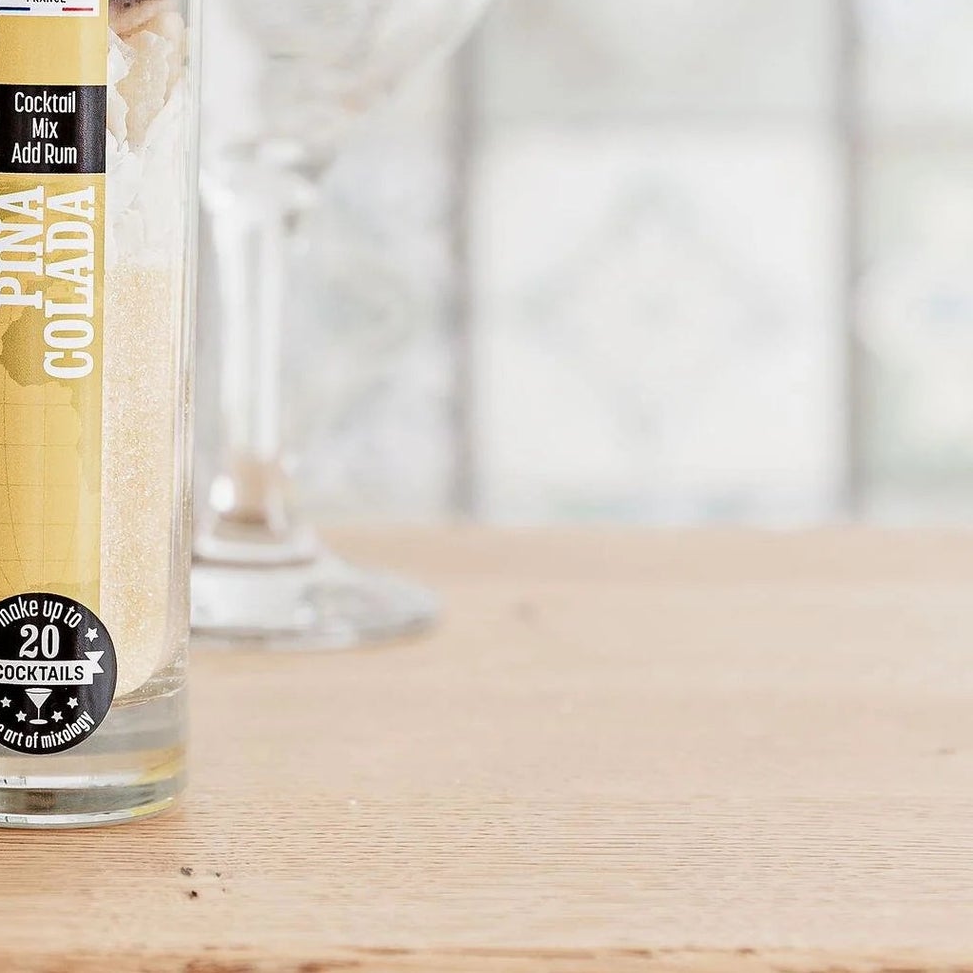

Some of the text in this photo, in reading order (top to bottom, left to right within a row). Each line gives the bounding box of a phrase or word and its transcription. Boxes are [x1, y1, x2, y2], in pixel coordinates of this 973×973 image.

[14, 91, 76, 113] Cocktail
[32, 118, 58, 139] Mix
[11, 142, 77, 164] Add Rum
[43, 185, 95, 379] COLADA
[42, 600, 63, 623] up
[63, 605, 83, 628] to
[19, 624, 60, 659] 20
[4, 730, 24, 747] art
[25, 731, 38, 748] of
[41, 710, 95, 749] mixology
